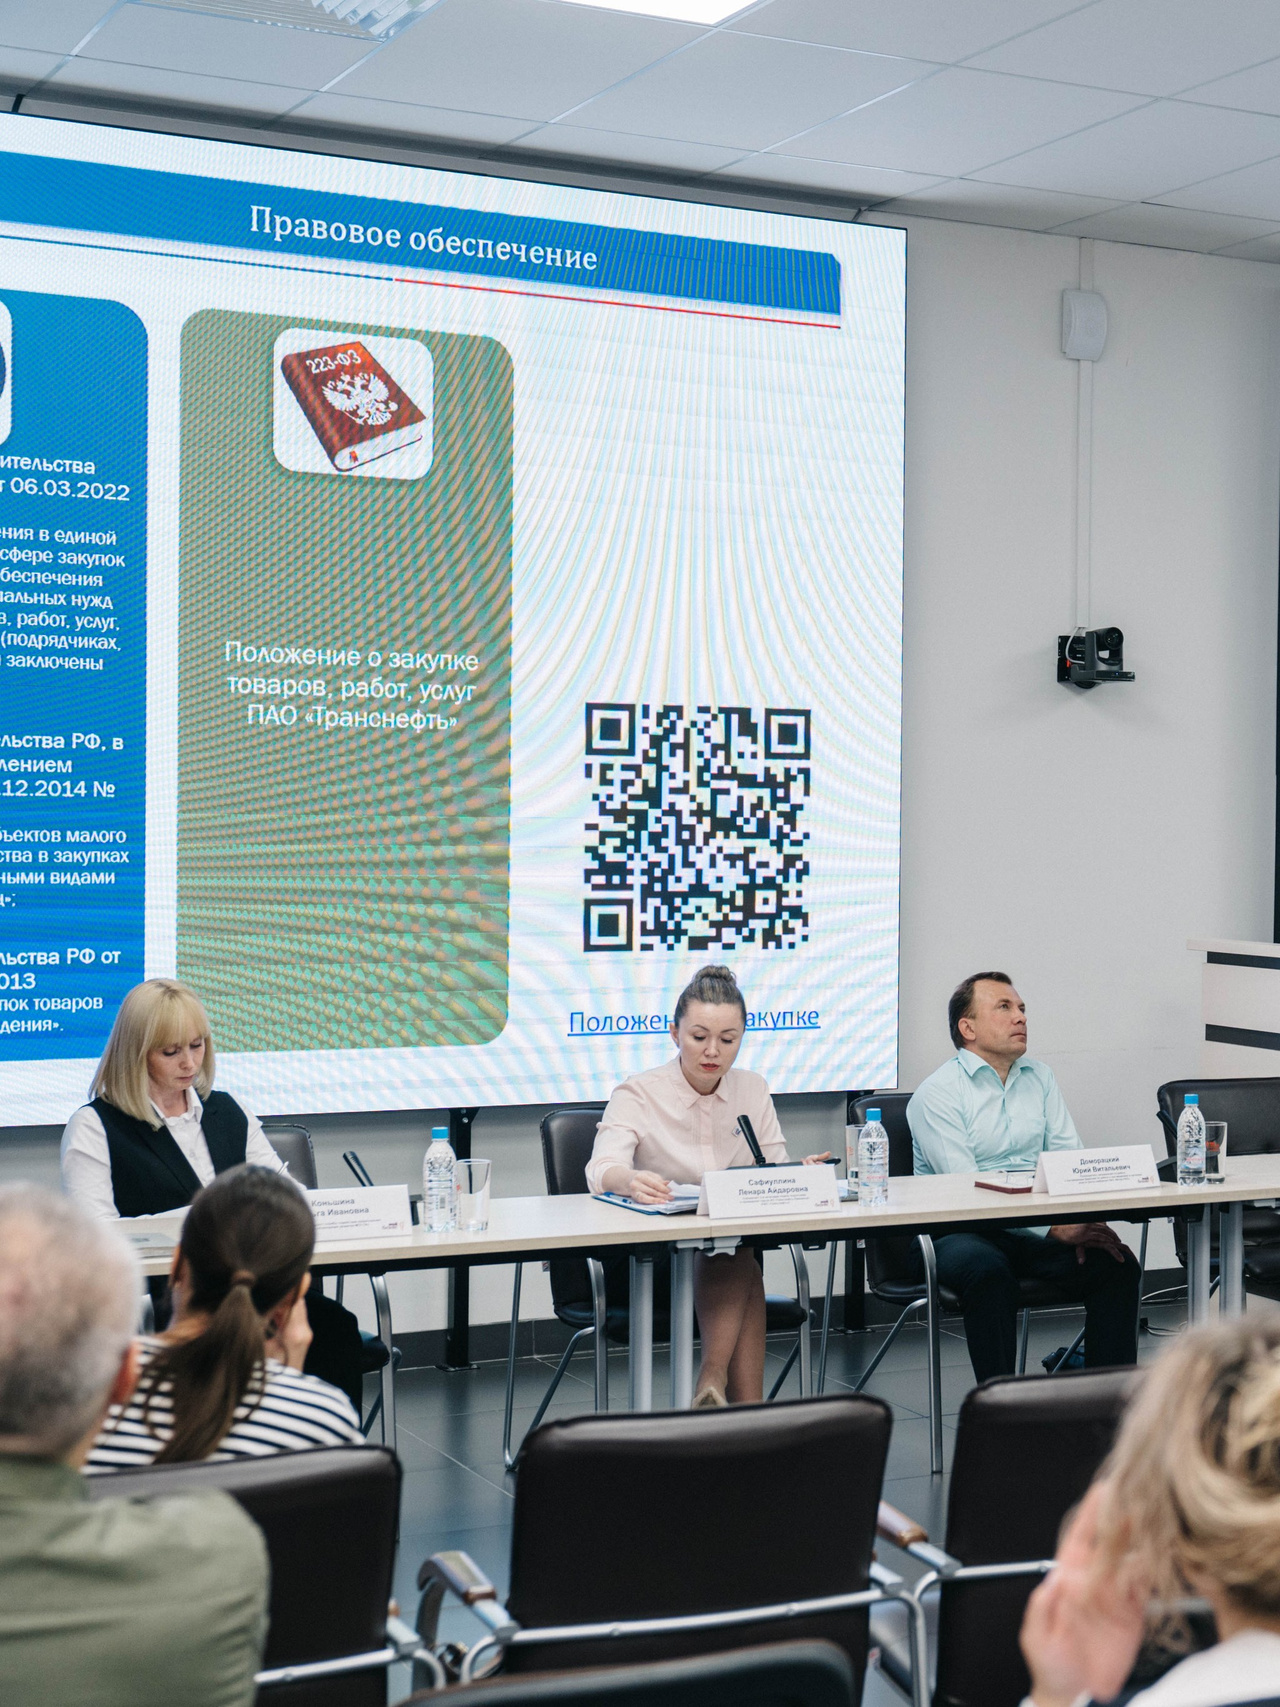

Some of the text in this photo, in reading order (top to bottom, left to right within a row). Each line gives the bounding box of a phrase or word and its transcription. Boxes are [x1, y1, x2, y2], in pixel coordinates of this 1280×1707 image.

[250, 205, 598, 270] Правовое обеспечение
[306, 349, 361, 374] 223-ФЗ
[10, 476, 130, 501] 06.03.2022
[39, 529, 117, 546] в единой
[0, 546, 126, 569] сфере закупок
[0, 590, 114, 610] альных нужд
[17, 611, 70, 629] работ,
[75, 615, 120, 632] услуг,
[1, 630, 122, 652] (подрядчиках,
[6, 654, 104, 671] заключены
[224, 640, 479, 674] Положение о закупке
[227, 676, 477, 705] товаров, работ, услуг
[248, 704, 457, 733] ПАО «Транснефть»
[0, 733, 124, 751] льства РФ, в
[93, 781, 116, 798] №
[66, 829, 127, 844] малого
[38, 850, 129, 867] в закупках
[50, 871, 116, 886] видами
[67, 947, 95, 965] РФ
[101, 951, 121, 965] от
[33, 996, 103, 1013] товаров
[569, 1009, 820, 1033] Положен акупке
[1093, 1165, 1131, 1173] Витальевич
[768, 1186, 808, 1195] Айдаровна
[328, 1208, 369, 1216] Ивановна
